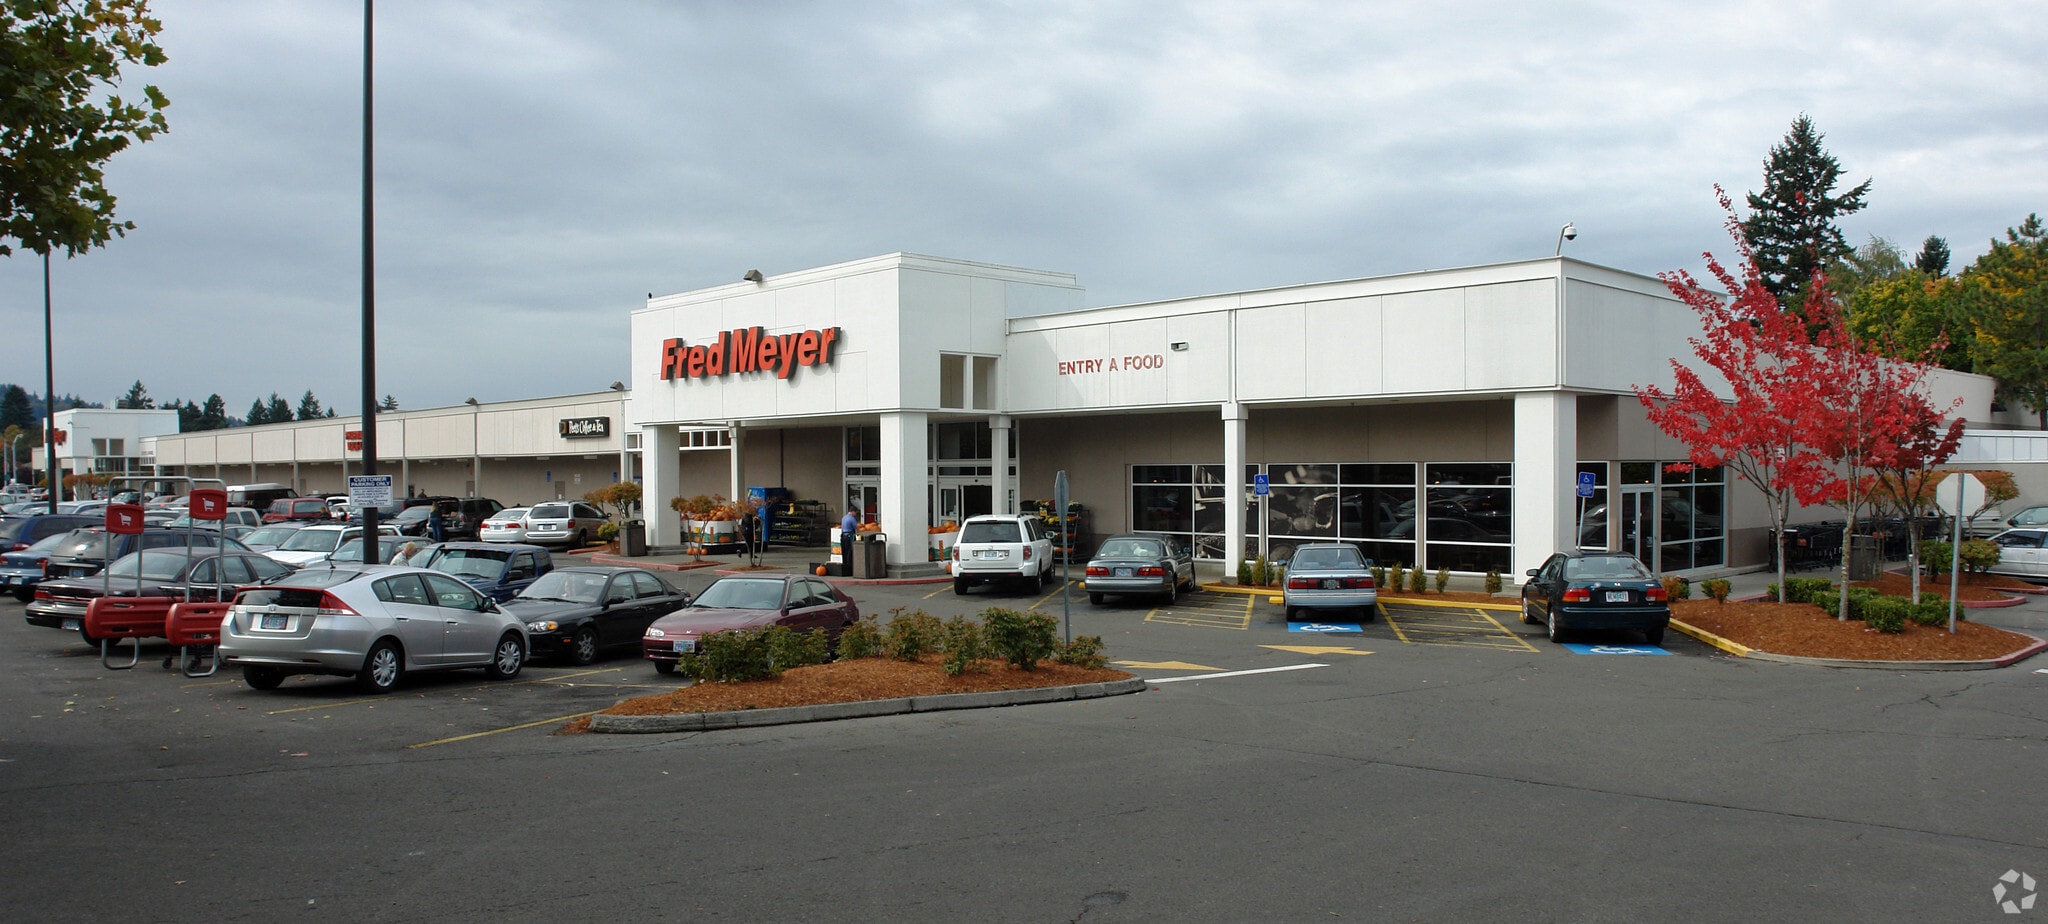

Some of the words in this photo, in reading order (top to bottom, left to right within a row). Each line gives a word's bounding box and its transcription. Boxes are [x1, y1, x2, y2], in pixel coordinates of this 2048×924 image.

[660, 331, 731, 380] Fred
[730, 326, 841, 380] Meyer
[1058, 359, 1103, 375] ENTRY
[1109, 357, 1118, 371] A
[1123, 354, 1164, 370] FOOD
[580, 420, 592, 434] Coffee
[595, 419, 604, 432] Tea
